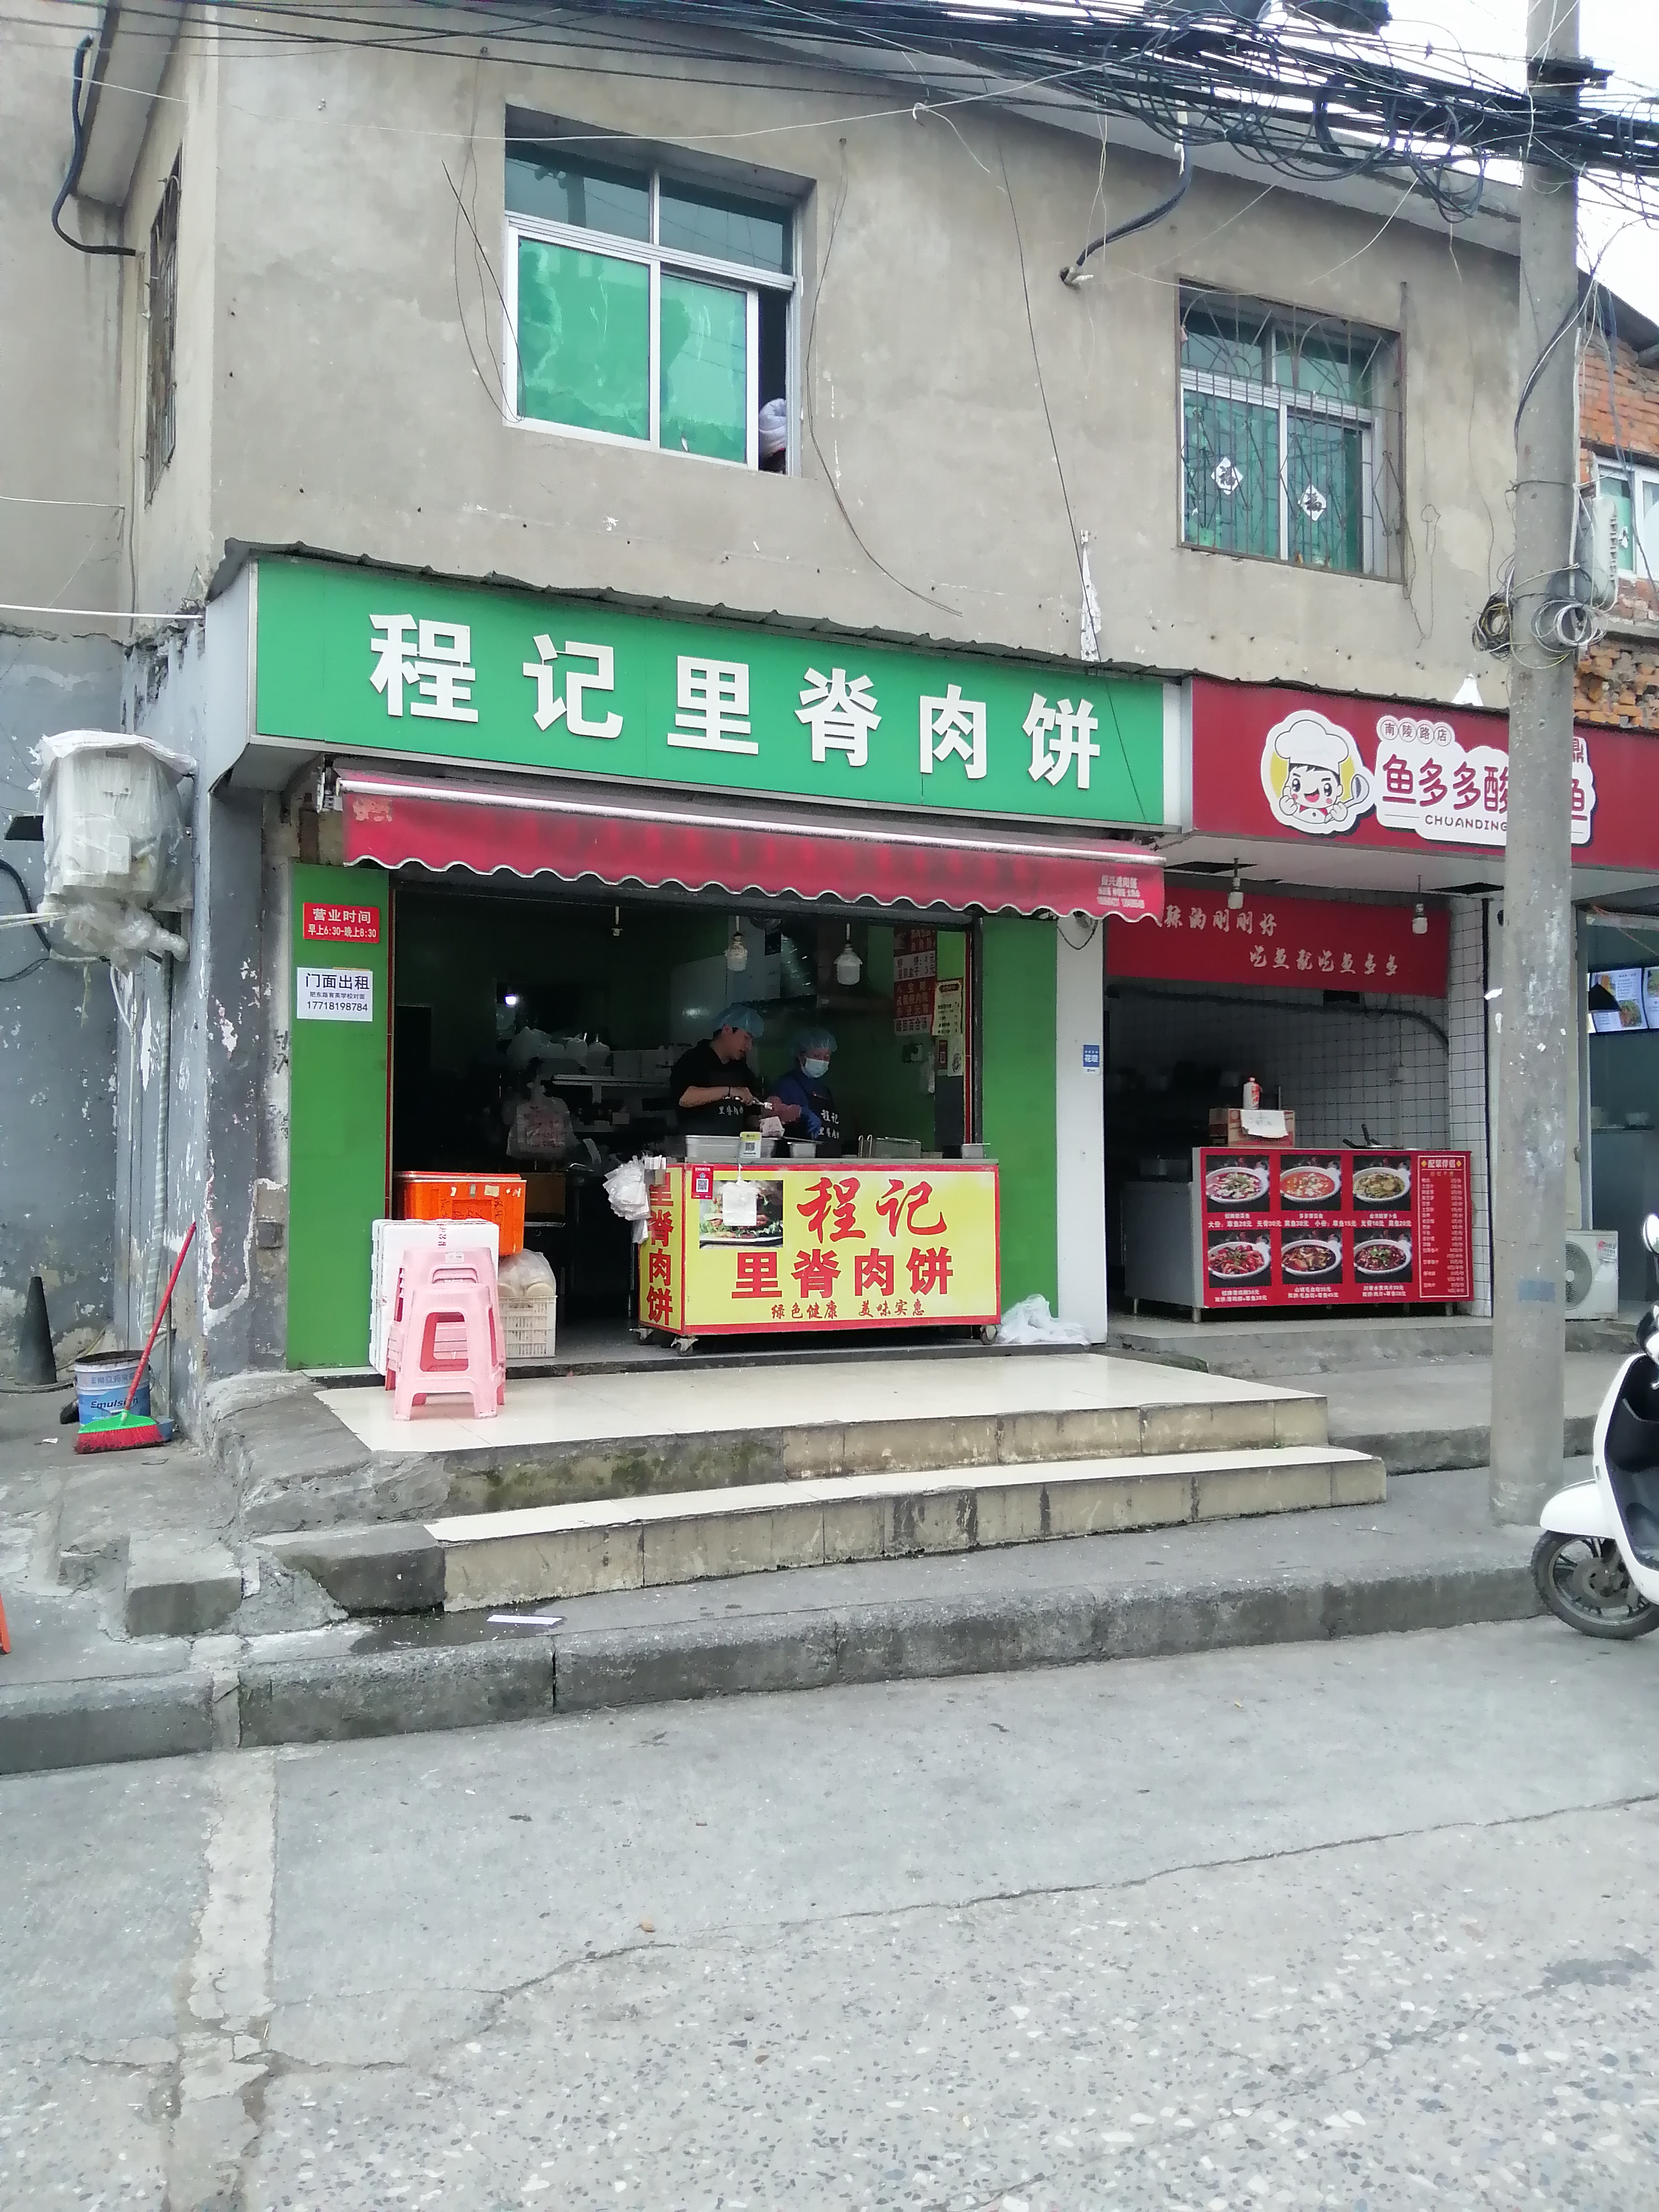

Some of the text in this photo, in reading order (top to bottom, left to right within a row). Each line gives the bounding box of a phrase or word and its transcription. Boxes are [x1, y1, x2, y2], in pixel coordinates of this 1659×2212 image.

[369, 614, 1101, 789] 程记里脊肉饼
[1385, 722, 1447, 742] 南陵路店
[313, 908, 371, 924] 营业时间
[308, 924, 377, 938] 早上6:30-晚上8:30
[1250, 945, 1398, 976] 吃鱼就吃鱼多多
[306, 973, 370, 990] 门面出租
[309, 991, 366, 1000] 肥东路育英学校对面
[307, 1001, 368, 1011] 17718198784
[797, 1177, 948, 1243] 程记
[731, 1246, 953, 1299] 里脊肉饼
[771, 1298, 925, 1319] 绿色健康 美味实惠
[90, 1397, 139, 1409] Emulsin
